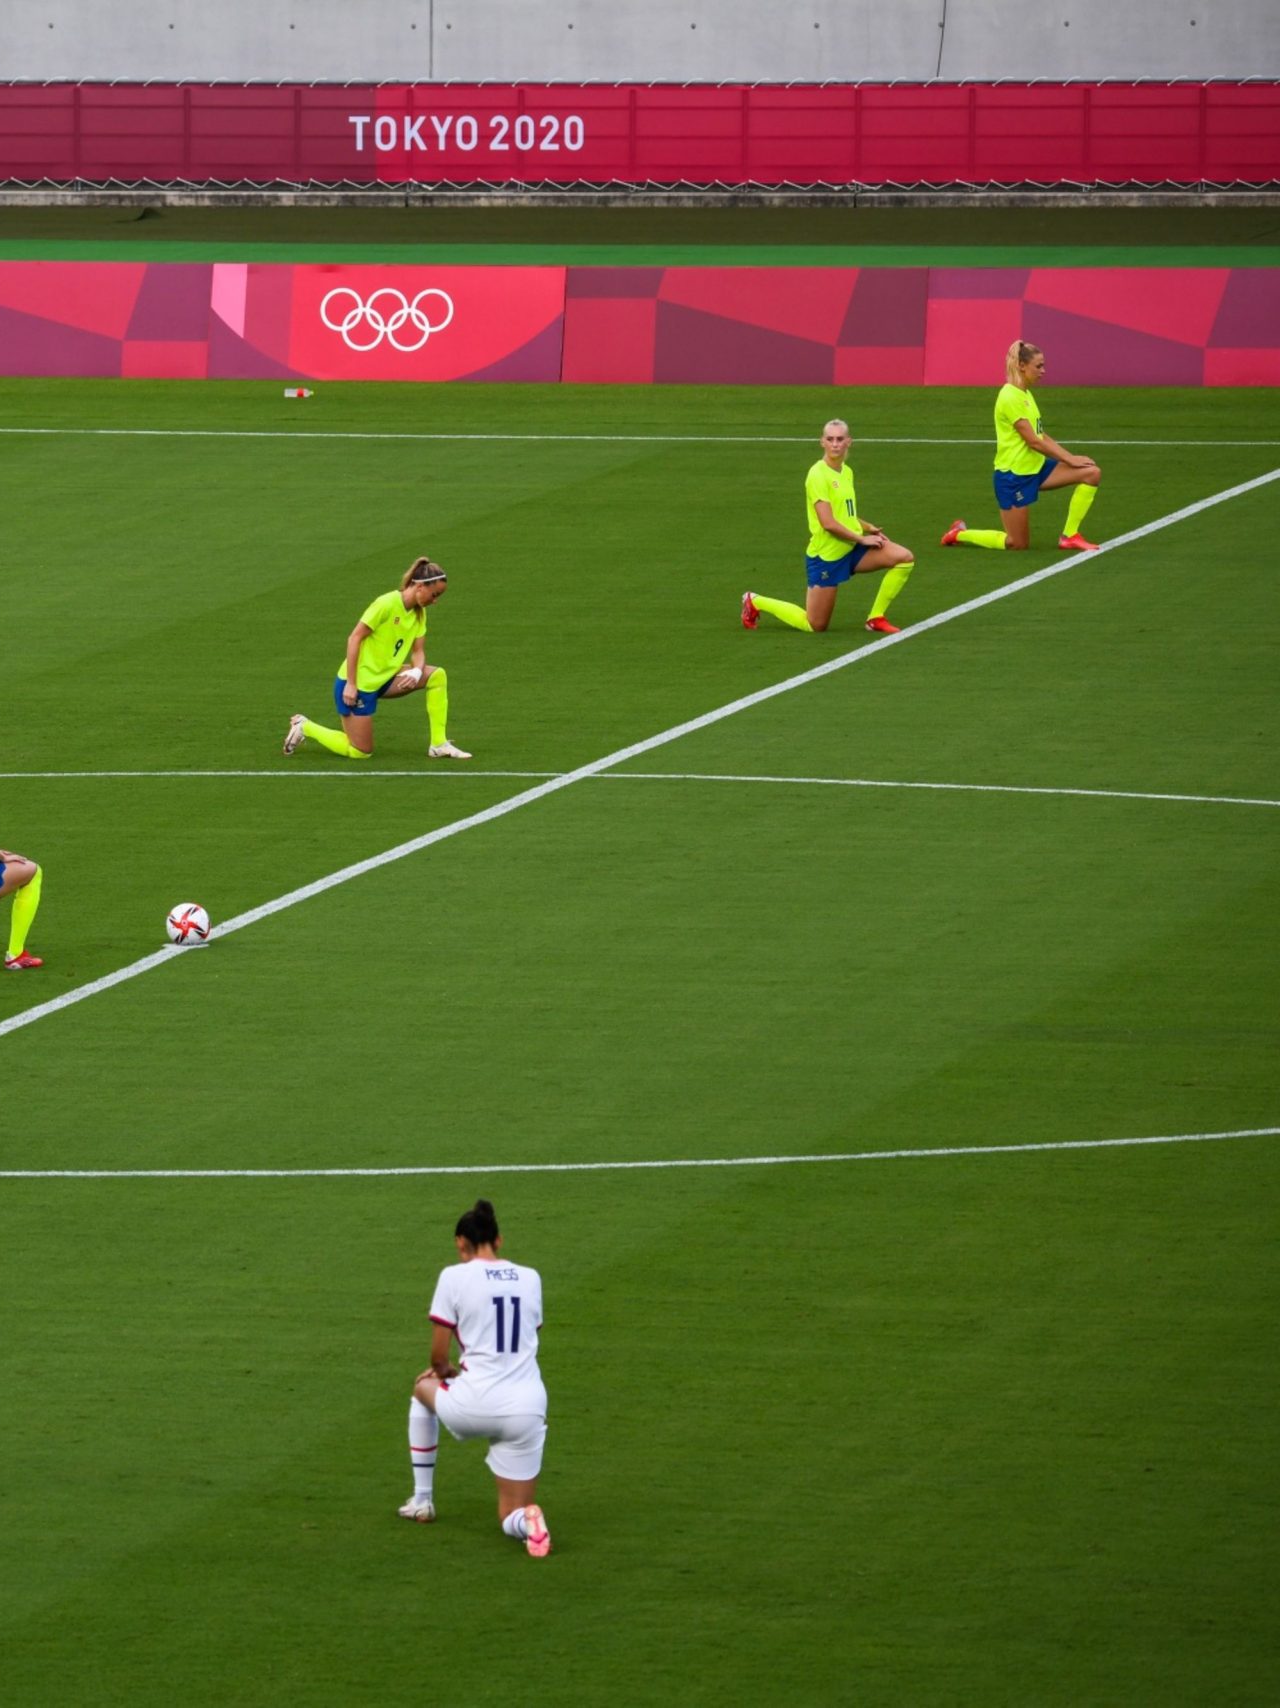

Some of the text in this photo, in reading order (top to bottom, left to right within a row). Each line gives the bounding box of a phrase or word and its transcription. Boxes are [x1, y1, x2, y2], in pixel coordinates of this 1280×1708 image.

[348, 115, 584, 151] TOKYO 2020
[392, 638, 404, 657] 9
[485, 1268, 519, 1281] PRESS
[492, 1296, 521, 1353] 11
